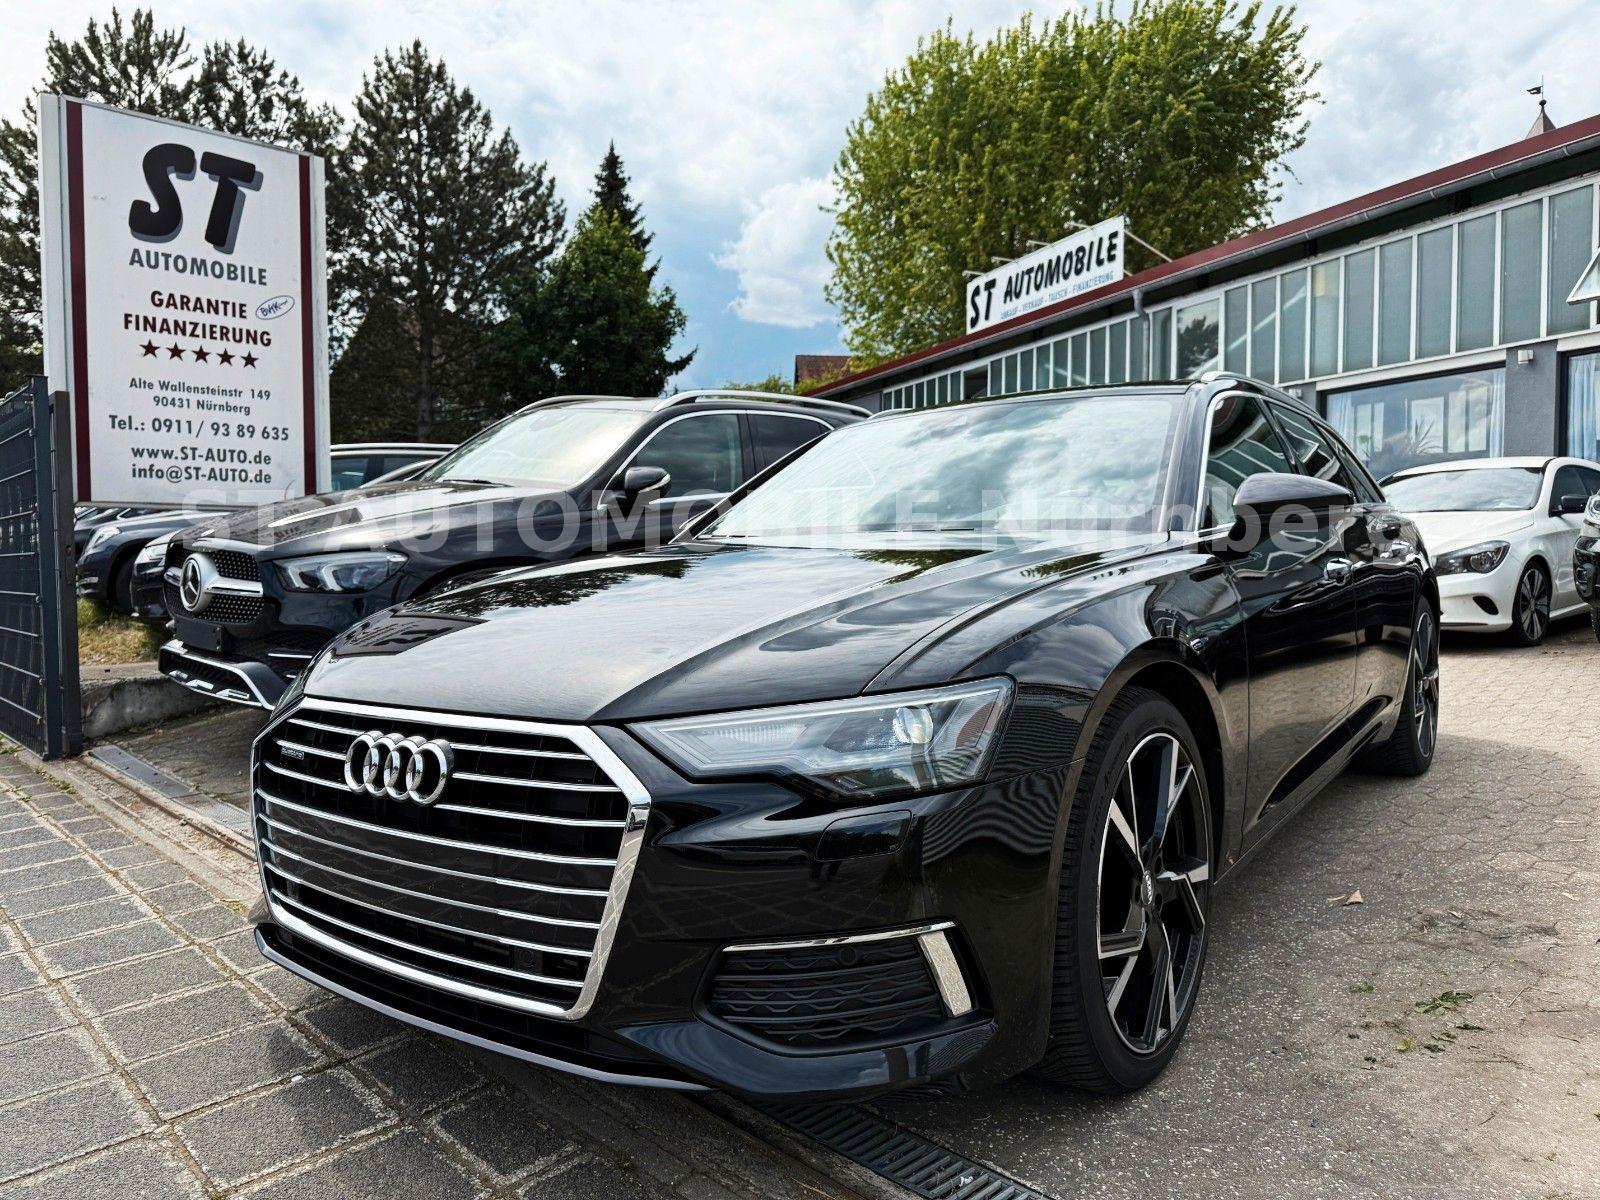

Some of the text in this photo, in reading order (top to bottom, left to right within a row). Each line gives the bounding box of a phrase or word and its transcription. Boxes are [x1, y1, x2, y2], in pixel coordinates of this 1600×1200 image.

[128, 143, 264, 255] ST
[129, 248, 267, 286] AUTOMOBILE
[970, 230, 1119, 329] ST AUTOMOBILE
[150, 290, 247, 319] GARANTIE
[123, 313, 272, 347] FINANZIERUNG
[129, 377, 271, 401] Alte Wallensteinstr 149
[153, 396, 251, 416] 90431 Nürnberg
[109, 415, 145, 431] Tel.:
[210, 422, 230, 437] 93
[237, 425, 256, 439] 89
[261, 426, 289, 441] 635
[131, 446, 272, 465] www.ST-AUTO.de
[131, 464, 272, 484] info@ST-AUTO.de
